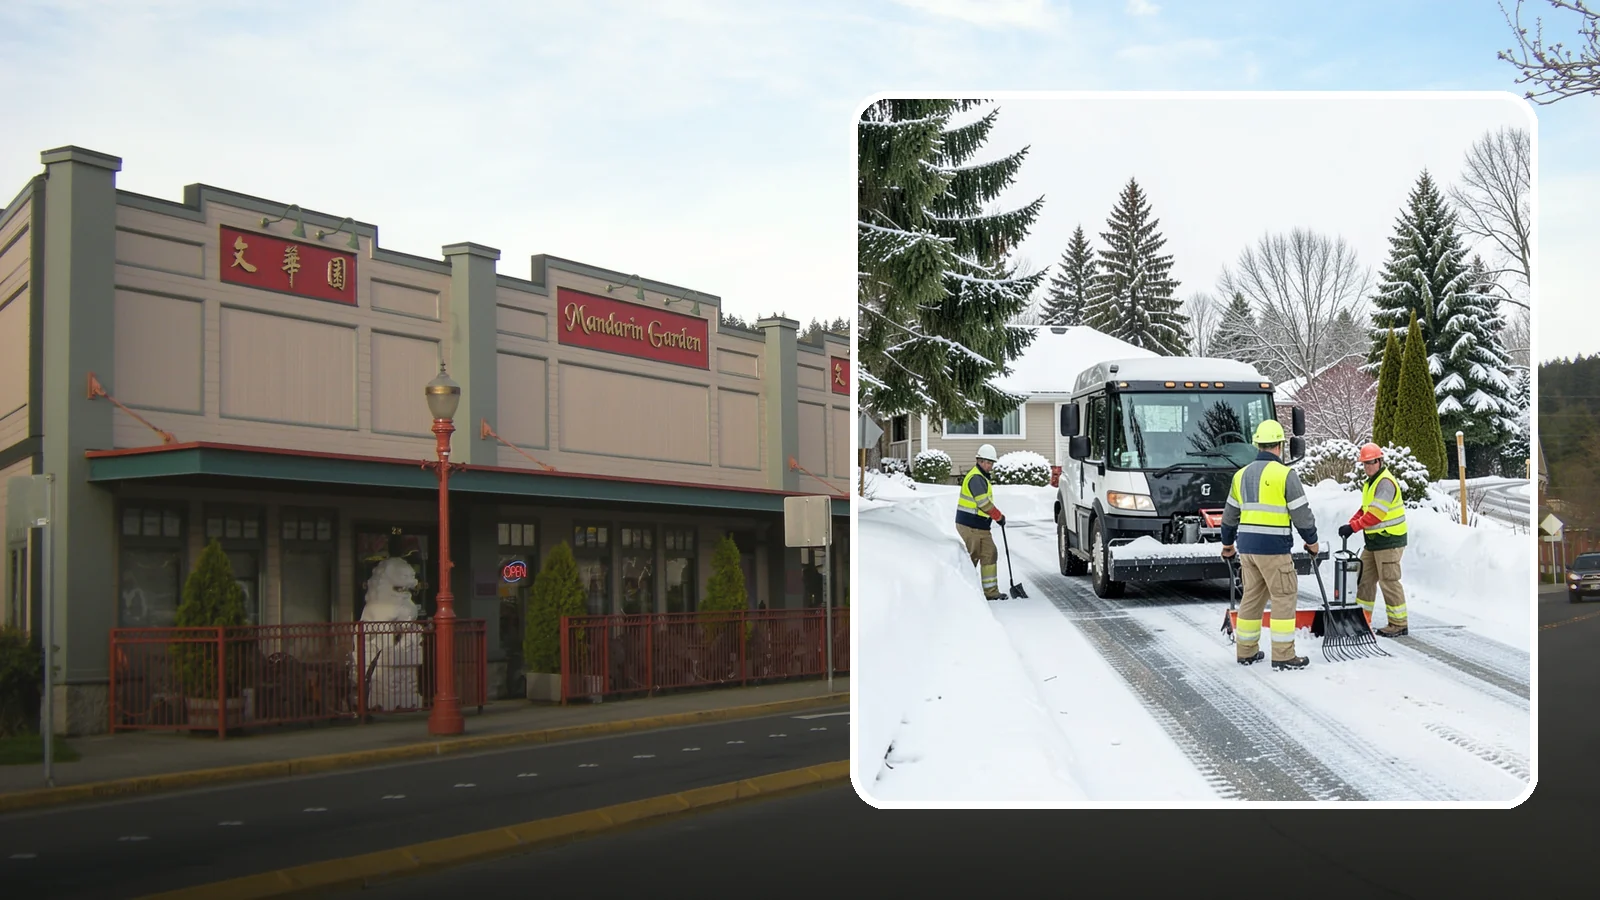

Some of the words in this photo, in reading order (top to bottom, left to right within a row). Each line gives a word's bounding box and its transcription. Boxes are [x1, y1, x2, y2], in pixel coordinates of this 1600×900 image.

[564, 302, 644, 341] Mandarin
[648, 320, 702, 352] Garden
[503, 565, 527, 578] OPEN
